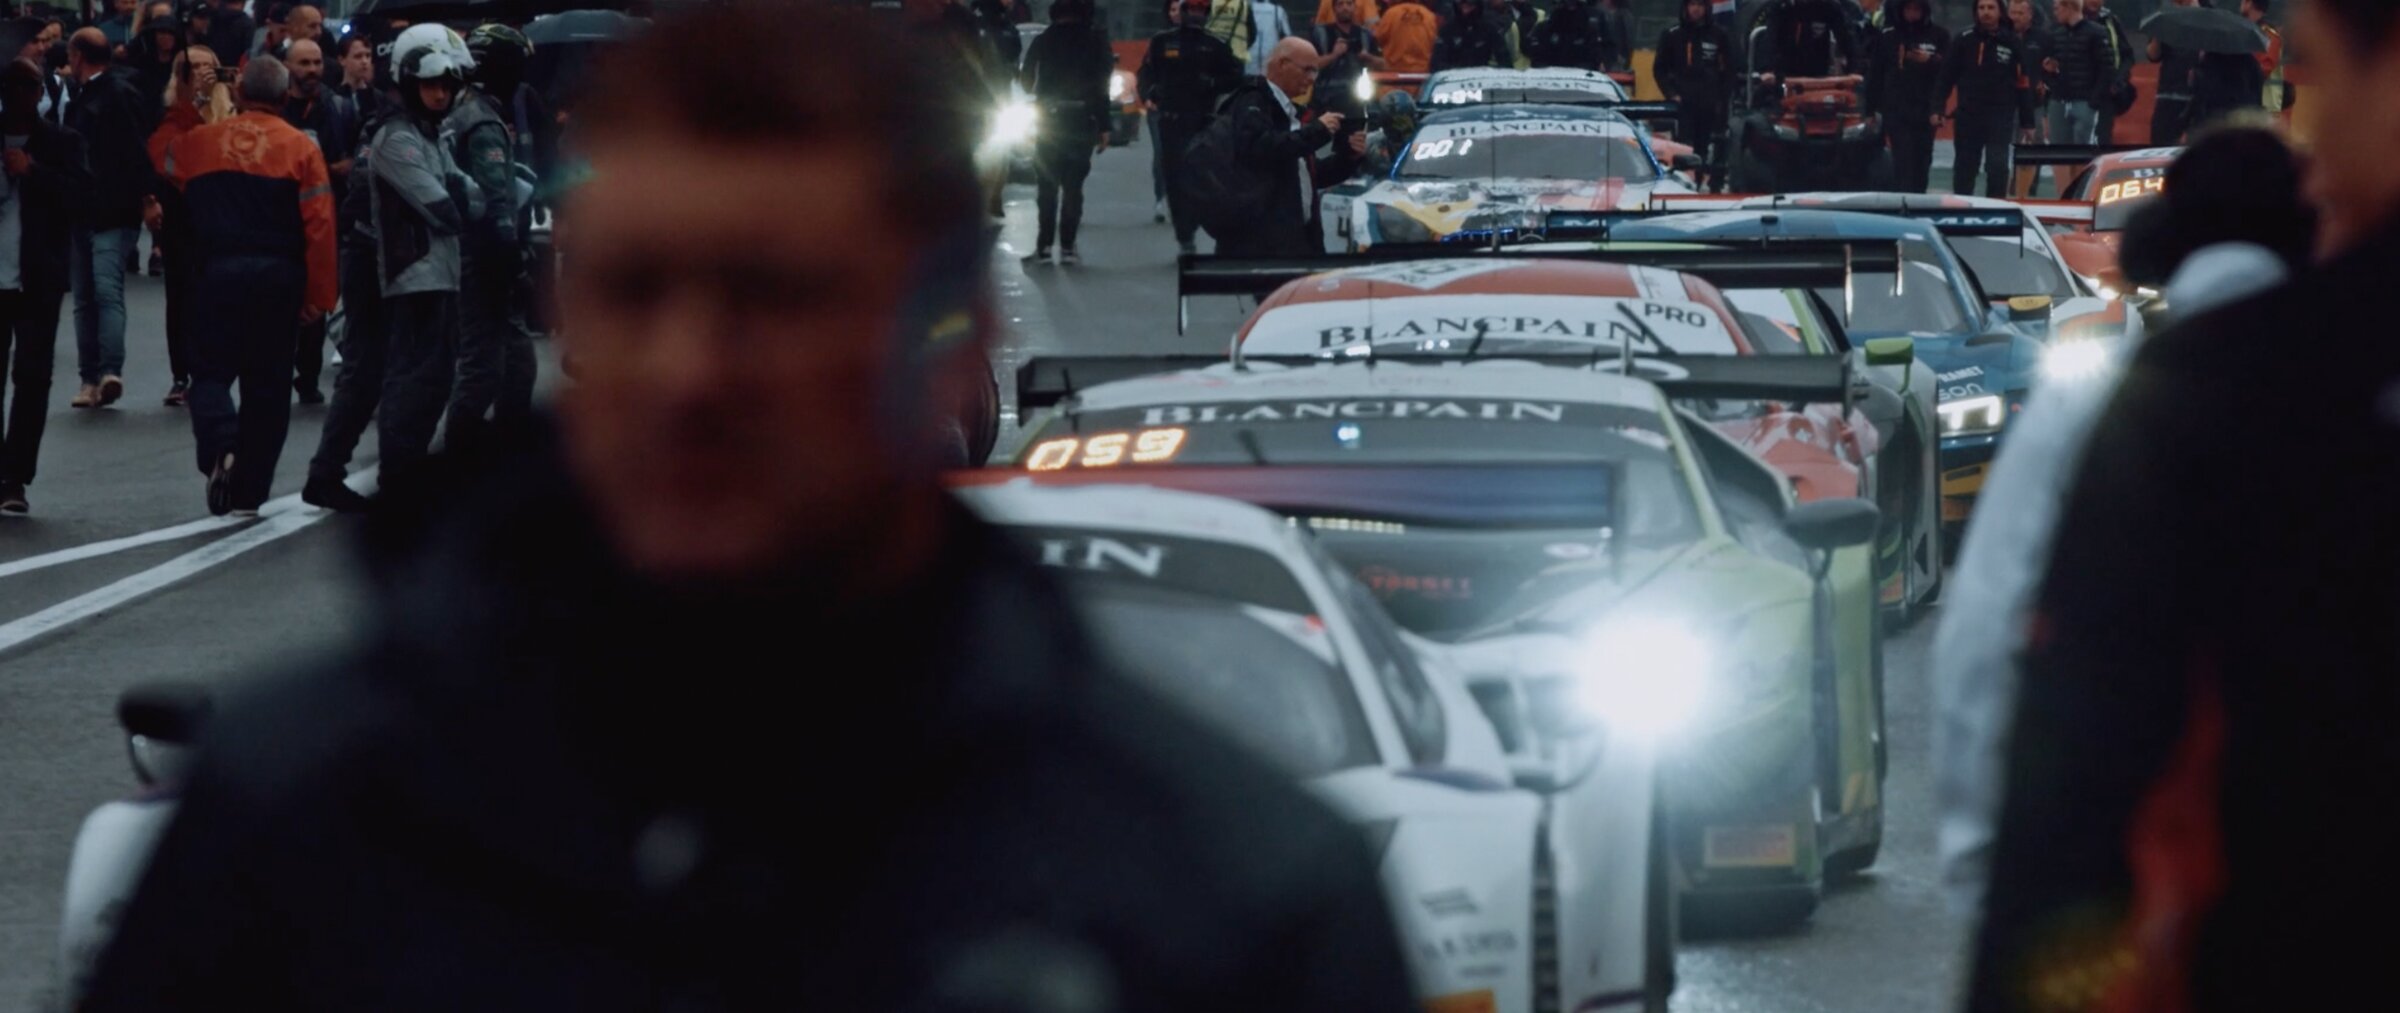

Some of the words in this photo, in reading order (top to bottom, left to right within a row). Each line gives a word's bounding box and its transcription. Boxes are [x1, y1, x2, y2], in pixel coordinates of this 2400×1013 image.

[1459, 79, 1591, 90] BLANCPAIN
[1450, 122, 1602, 138] BLANCPAIN
[1414, 139, 1472, 161] 001
[2099, 176, 2164, 206] 064
[1645, 302, 1706, 328] PRO
[1317, 316, 1647, 348] BLANCPAIN
[1938, 383, 1984, 401] son
[1142, 401, 1564, 425] BLANCPAIN
[1027, 427, 1186, 471] 059
[1038, 536, 1164, 579] IN
